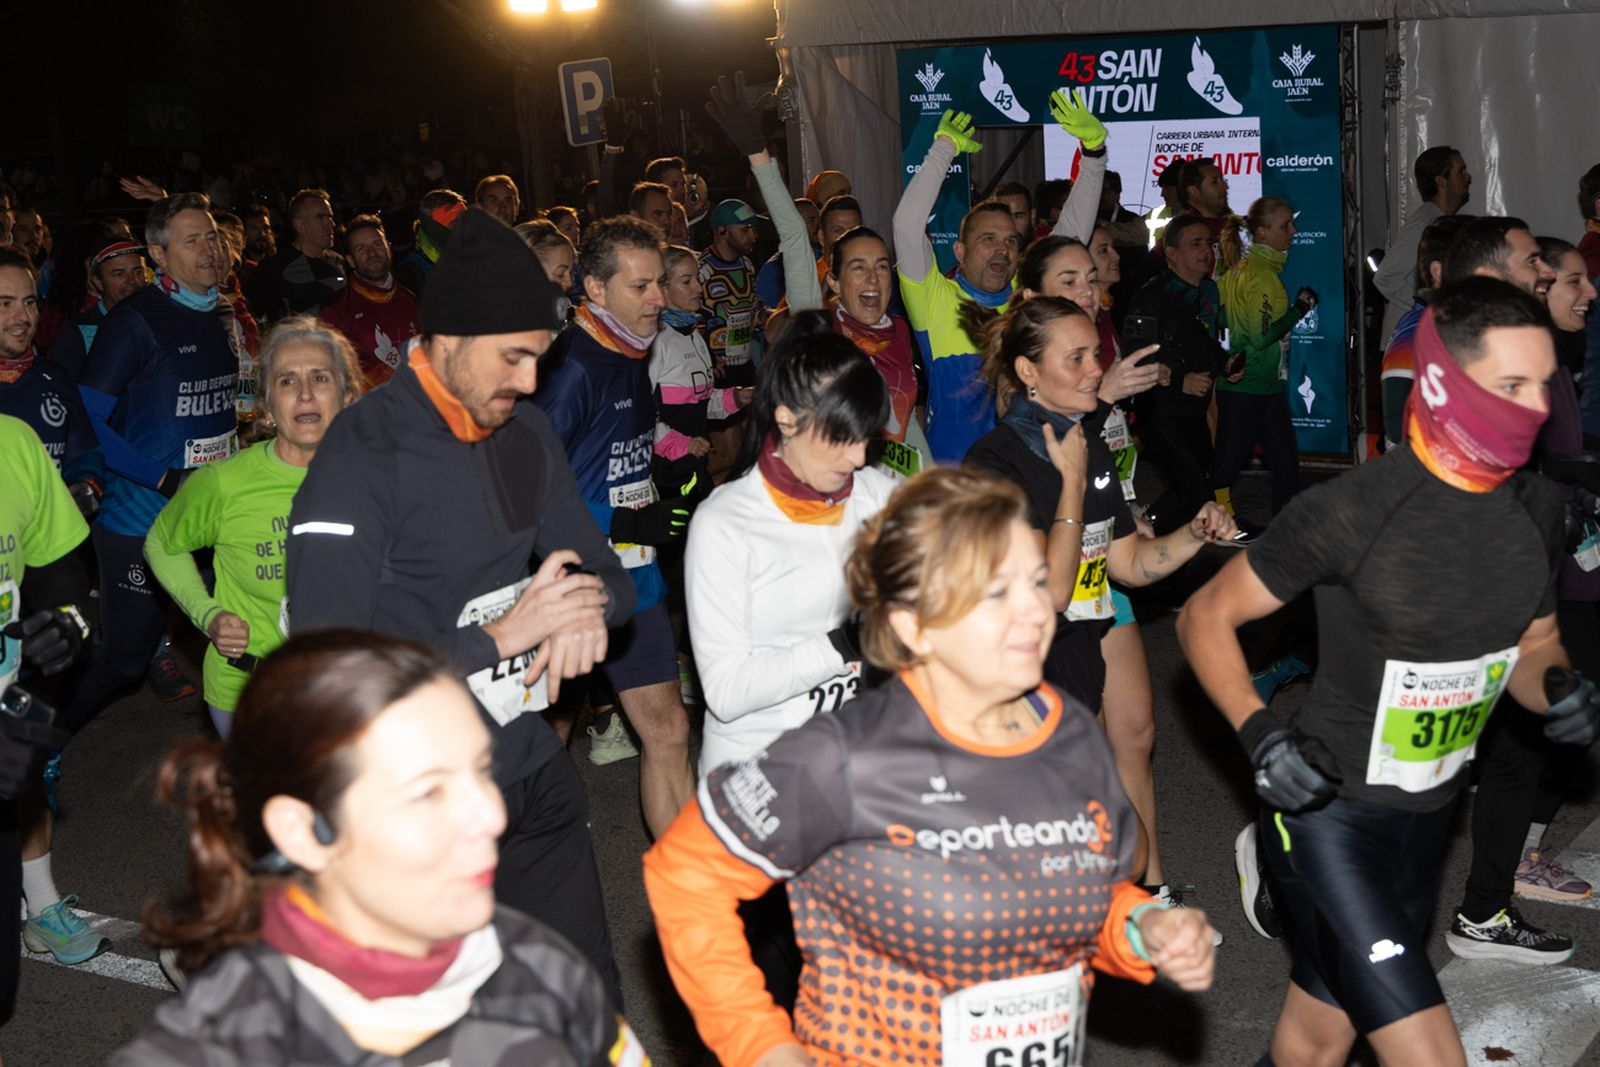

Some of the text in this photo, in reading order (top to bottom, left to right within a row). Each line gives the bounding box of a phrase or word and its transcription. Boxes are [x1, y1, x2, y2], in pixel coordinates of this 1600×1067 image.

[1058, 48, 1162, 83] 43 SAN
[1272, 77, 1324, 88] CAJA RURAL
[910, 93, 952, 102] CAJA RURAL
[1204, 80, 1225, 103] 43
[572, 70, 604, 135] P
[994, 89, 1013, 111] 43
[143, 103, 187, 130] WC
[1156, 131, 1192, 140] CARRERA
[1193, 130, 1226, 139] URBANA
[1155, 142, 1204, 153] NOCHE DE
[1266, 154, 1333, 167] calderón
[178, 344, 197, 354] vive
[179, 380, 208, 394] CLUB
[614, 398, 633, 411] vive
[625, 490, 645, 503] NOCHE
[256, 541, 274, 557] DE
[256, 563, 283, 580] QUE
[1420, 675, 1477, 691] NOCHE DE
[1400, 694, 1430, 708] SAN
[1411, 702, 1483, 749] 3175
[1041, 854, 1071, 878] por
[993, 996, 1048, 1017] NOCHE
[970, 1022, 1007, 1043] SAN
